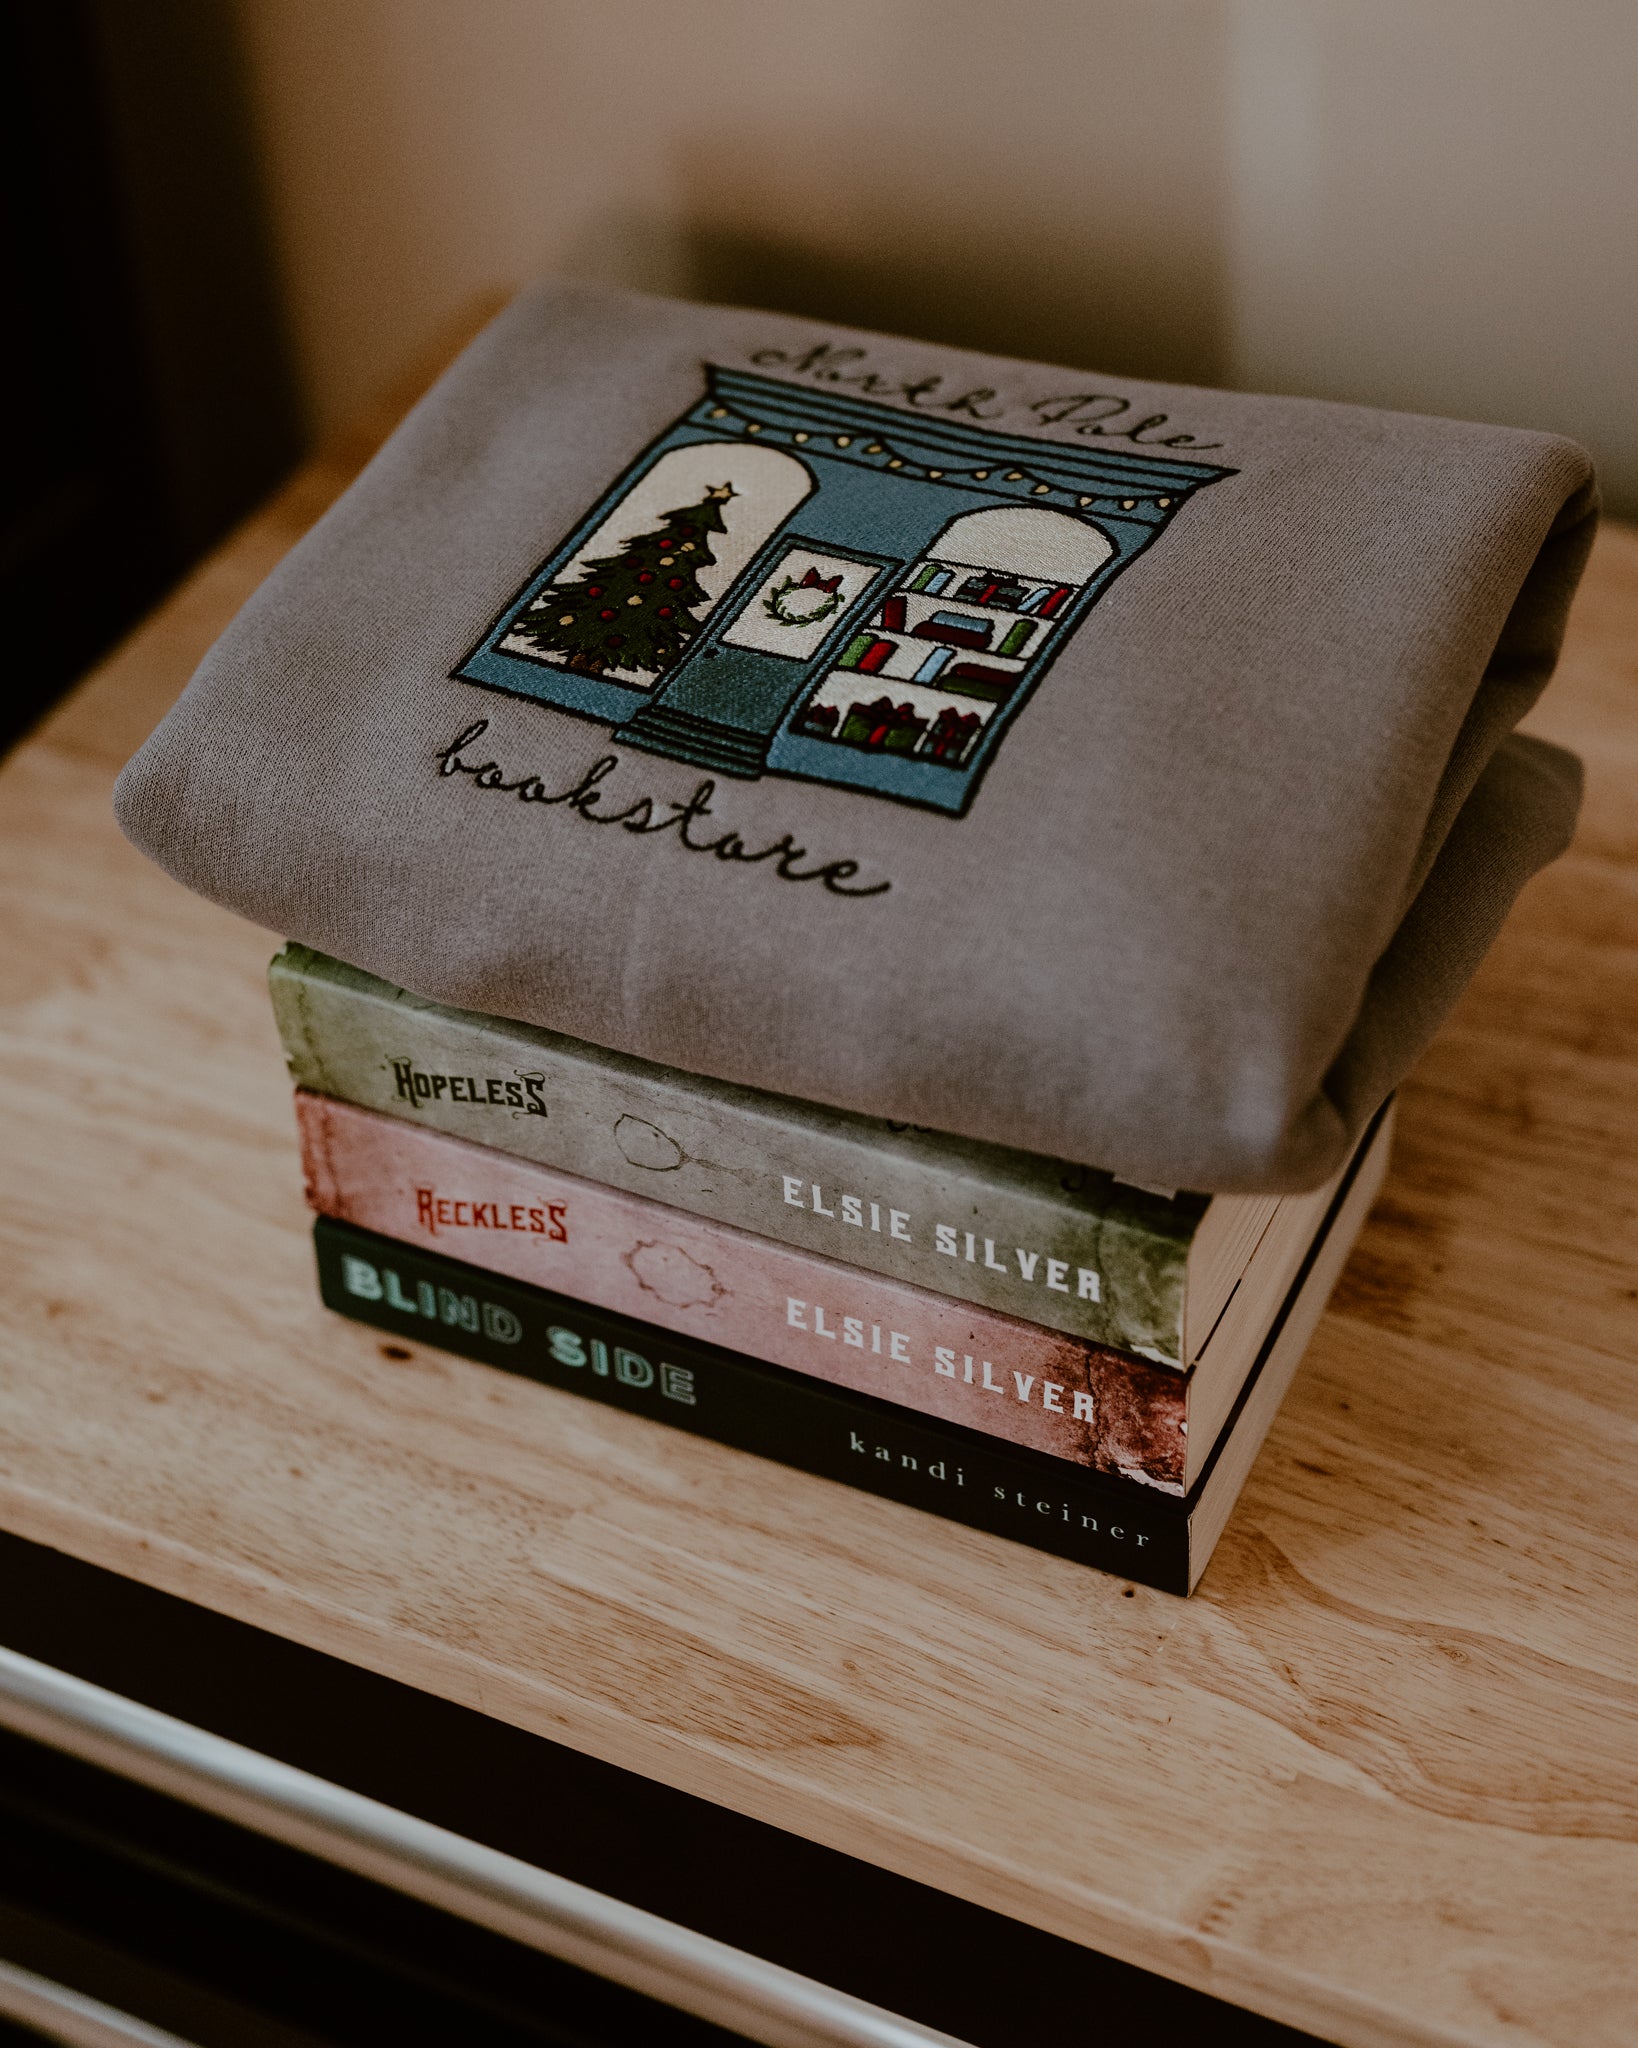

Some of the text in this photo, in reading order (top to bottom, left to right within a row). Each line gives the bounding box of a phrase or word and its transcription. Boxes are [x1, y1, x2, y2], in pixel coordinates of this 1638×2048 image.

[750, 342, 1223, 451] North Pole
[436, 718, 892, 897] bookstore
[392, 1056, 549, 1120] HOPELESS
[415, 1186, 570, 1245] RECKLESS
[782, 1175, 1101, 1303] ELSIE SILVER
[340, 1252, 697, 1406] BLIND SIDE
[786, 1297, 1096, 1424] ELSIE SILVER
[848, 1431, 1150, 1547] kandi steiner
